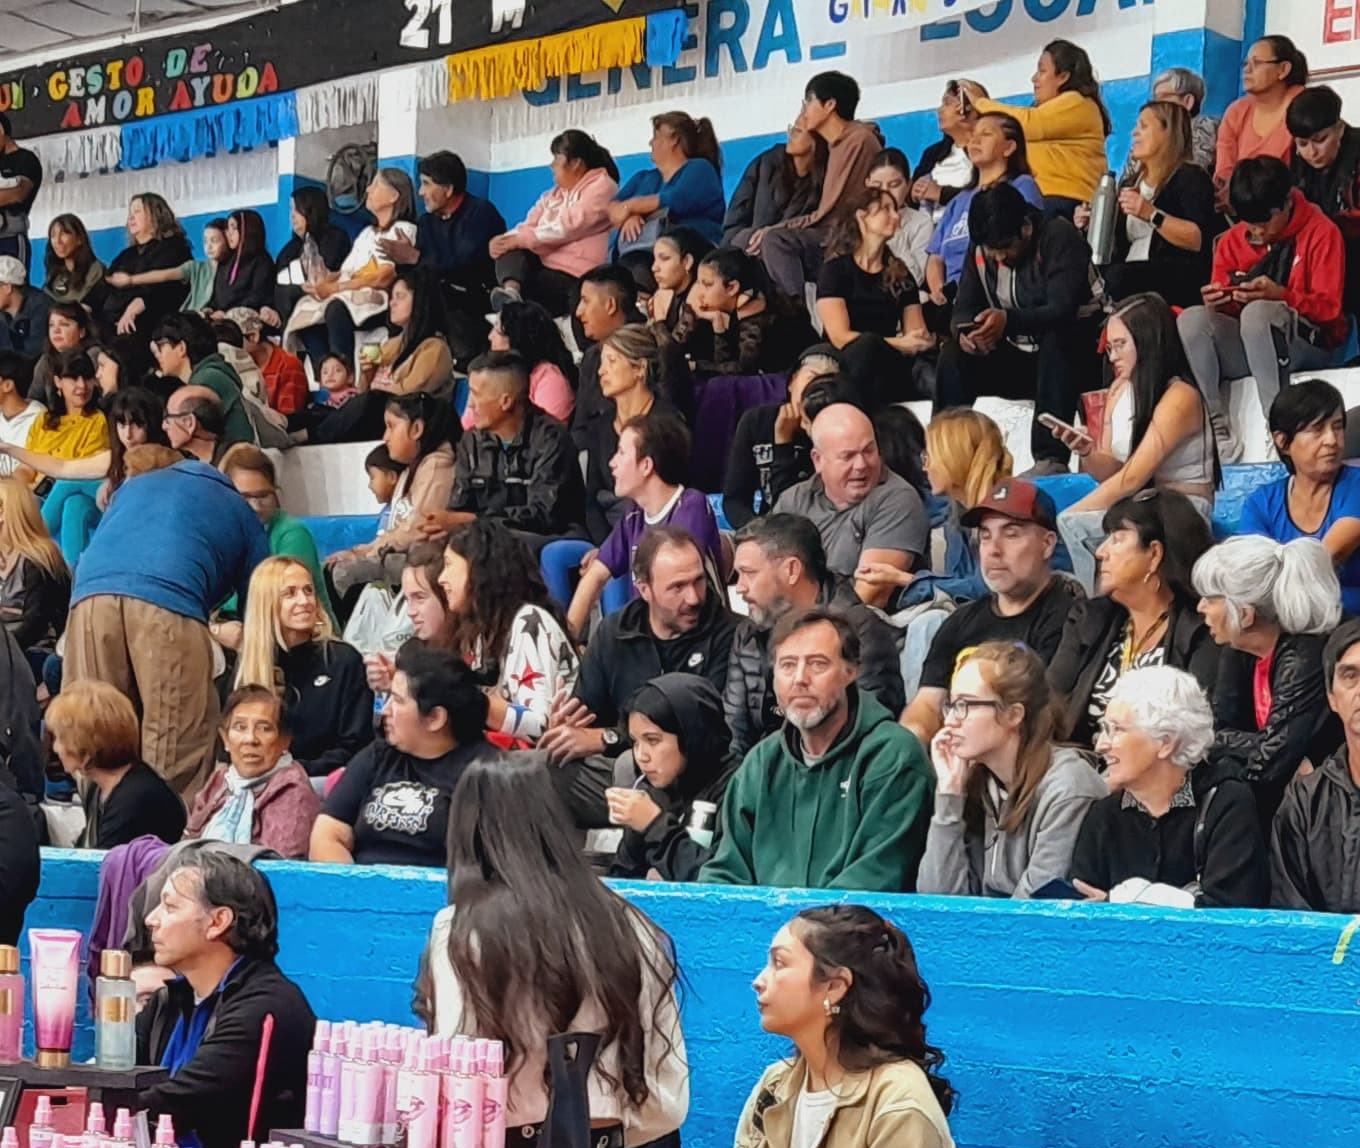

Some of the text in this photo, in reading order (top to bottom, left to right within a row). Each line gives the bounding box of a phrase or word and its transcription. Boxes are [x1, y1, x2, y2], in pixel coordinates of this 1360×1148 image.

[48, 56, 144, 101] GESTO
[165, 43, 212, 78] DE
[61, 62, 278, 128] AMOR AYUDA
